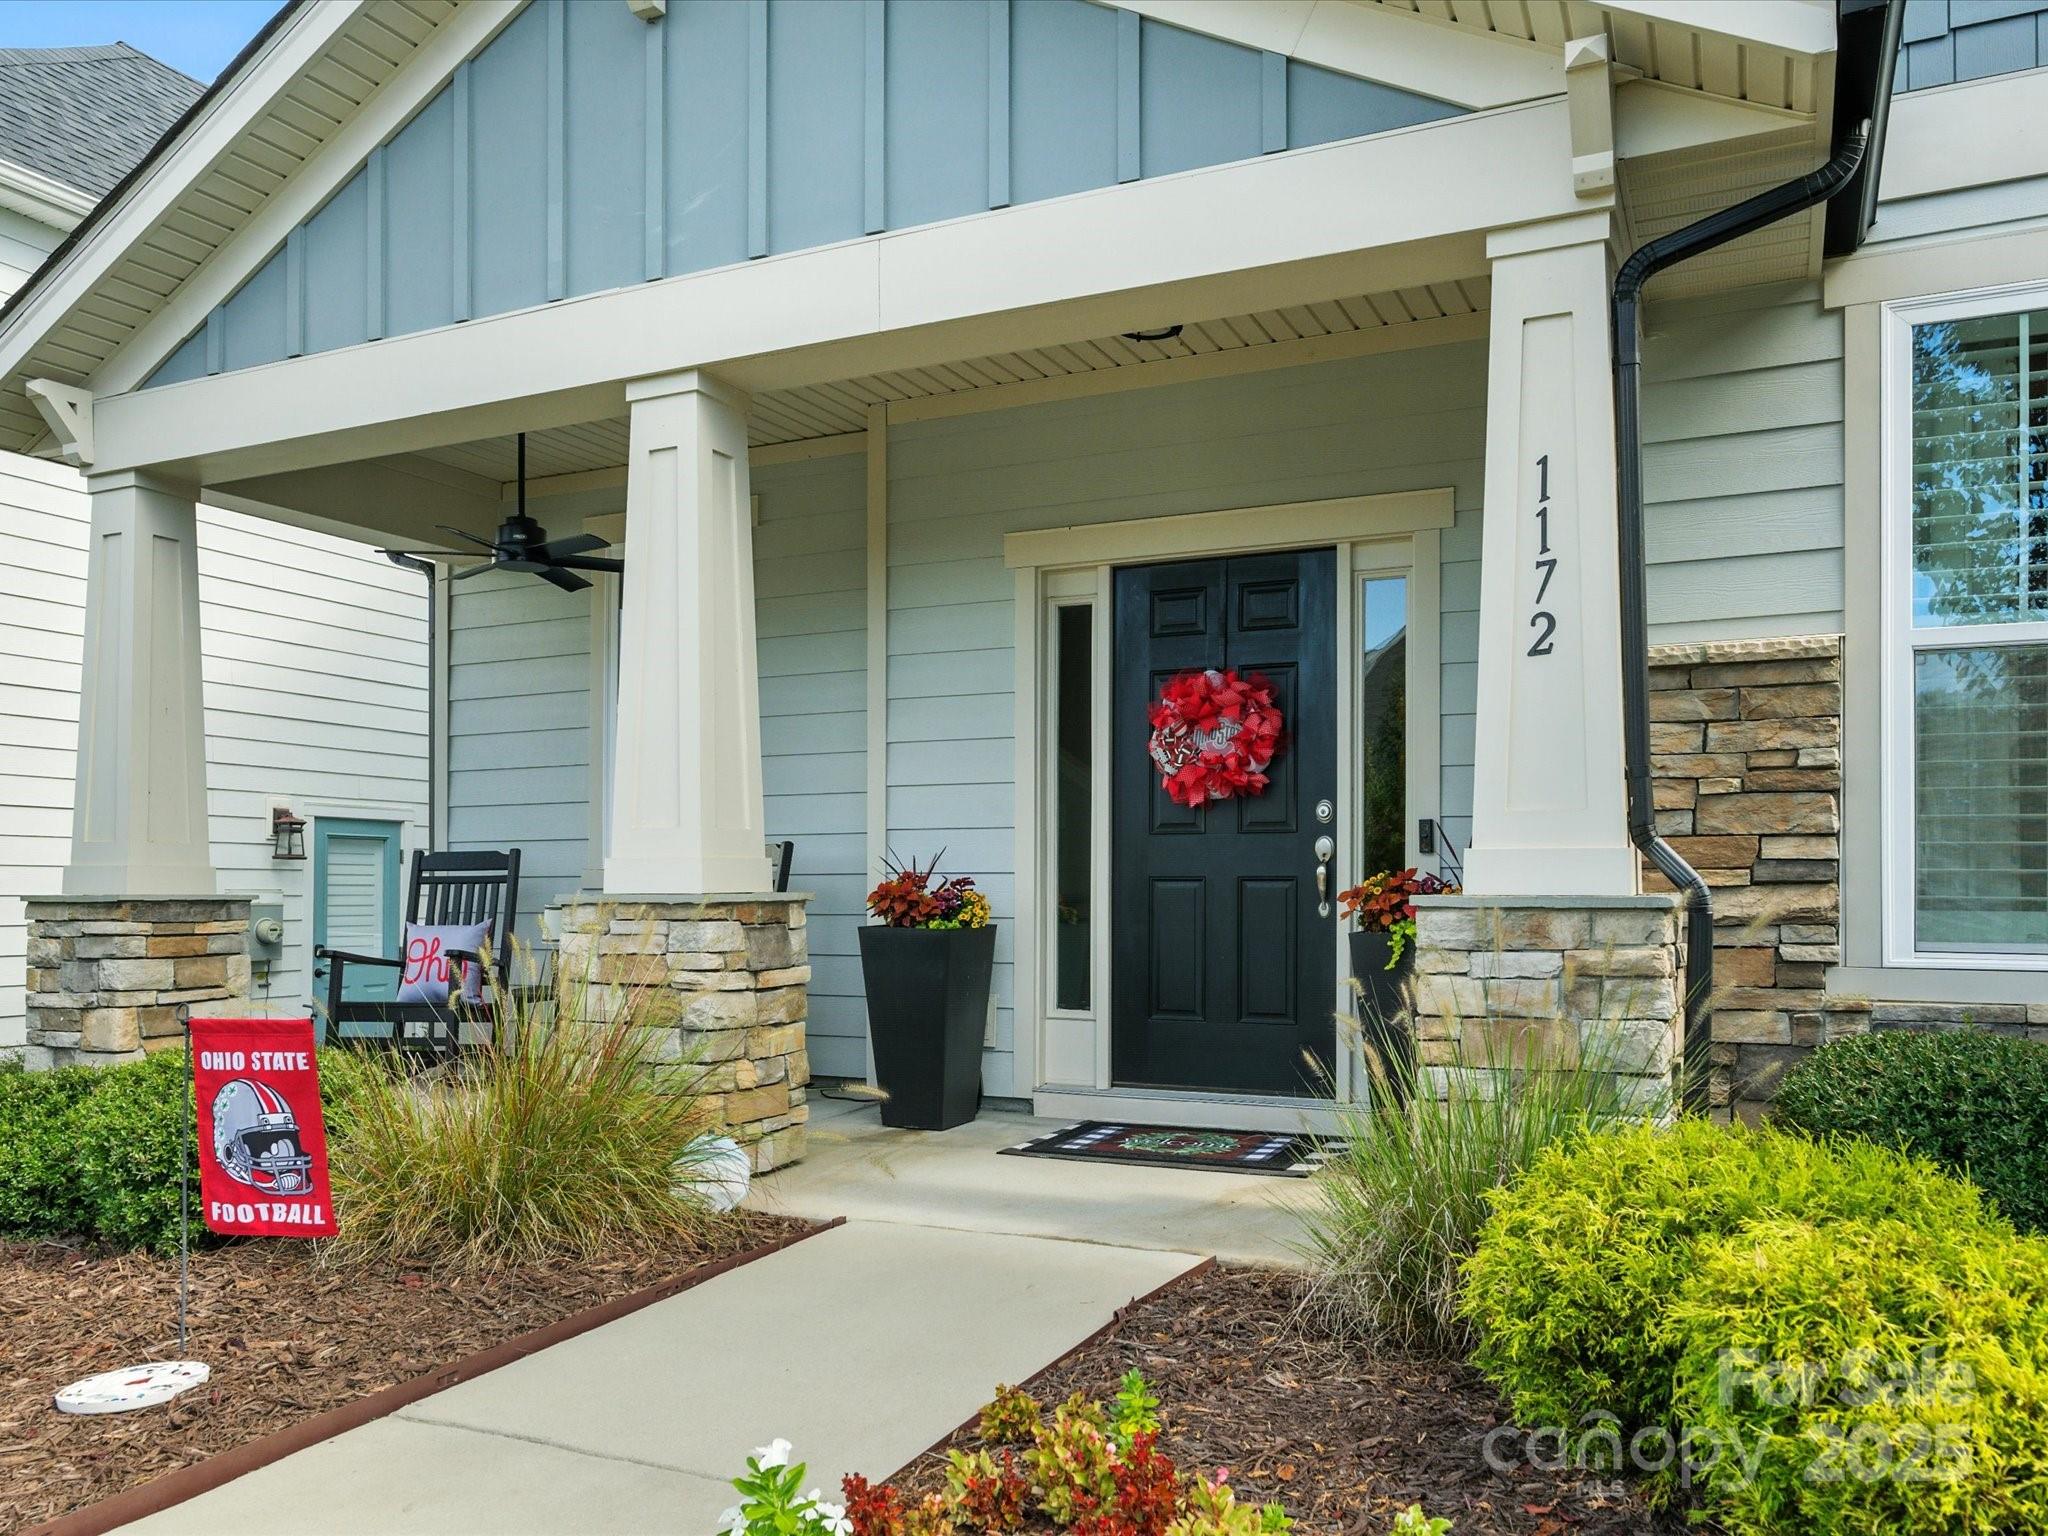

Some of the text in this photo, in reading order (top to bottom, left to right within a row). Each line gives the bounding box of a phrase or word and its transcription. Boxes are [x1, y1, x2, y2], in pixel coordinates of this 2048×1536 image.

[1527, 455, 1557, 657] 1172
[201, 1051, 310, 1071] OHIO STATE
[211, 1202, 326, 1225] FOOTBALL
